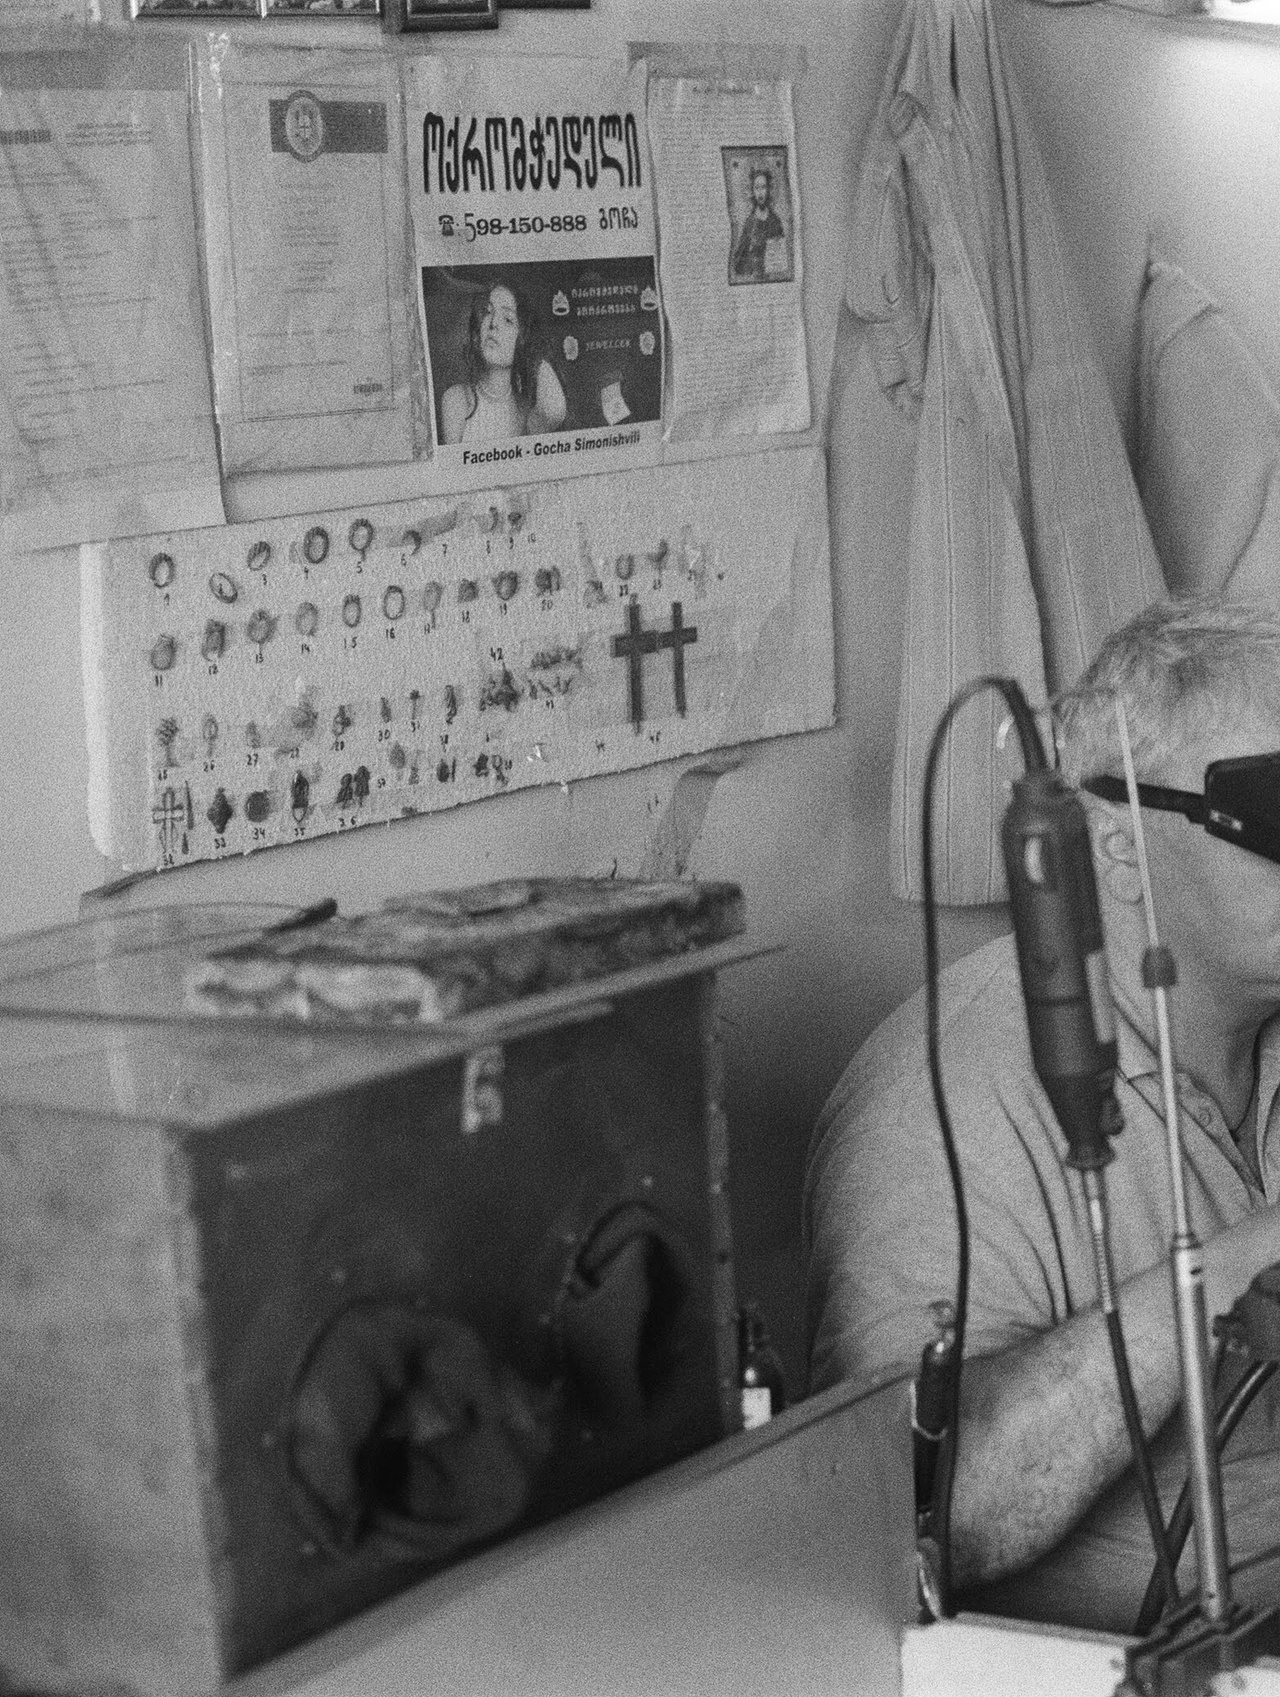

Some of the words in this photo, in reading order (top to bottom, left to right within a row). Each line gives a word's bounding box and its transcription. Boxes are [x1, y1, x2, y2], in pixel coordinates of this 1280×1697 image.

[423, 111, 642, 194] ოქრომჭედელი
[464, 213, 587, 242] 598-150-888
[463, 446, 522, 465] Facebook
[534, 441, 571, 456] Gocha
[574, 431, 640, 451] Simonishvili
[246, 753, 259, 765] 27
[378, 729, 391, 742] 30
[253, 828, 266, 840] 34
